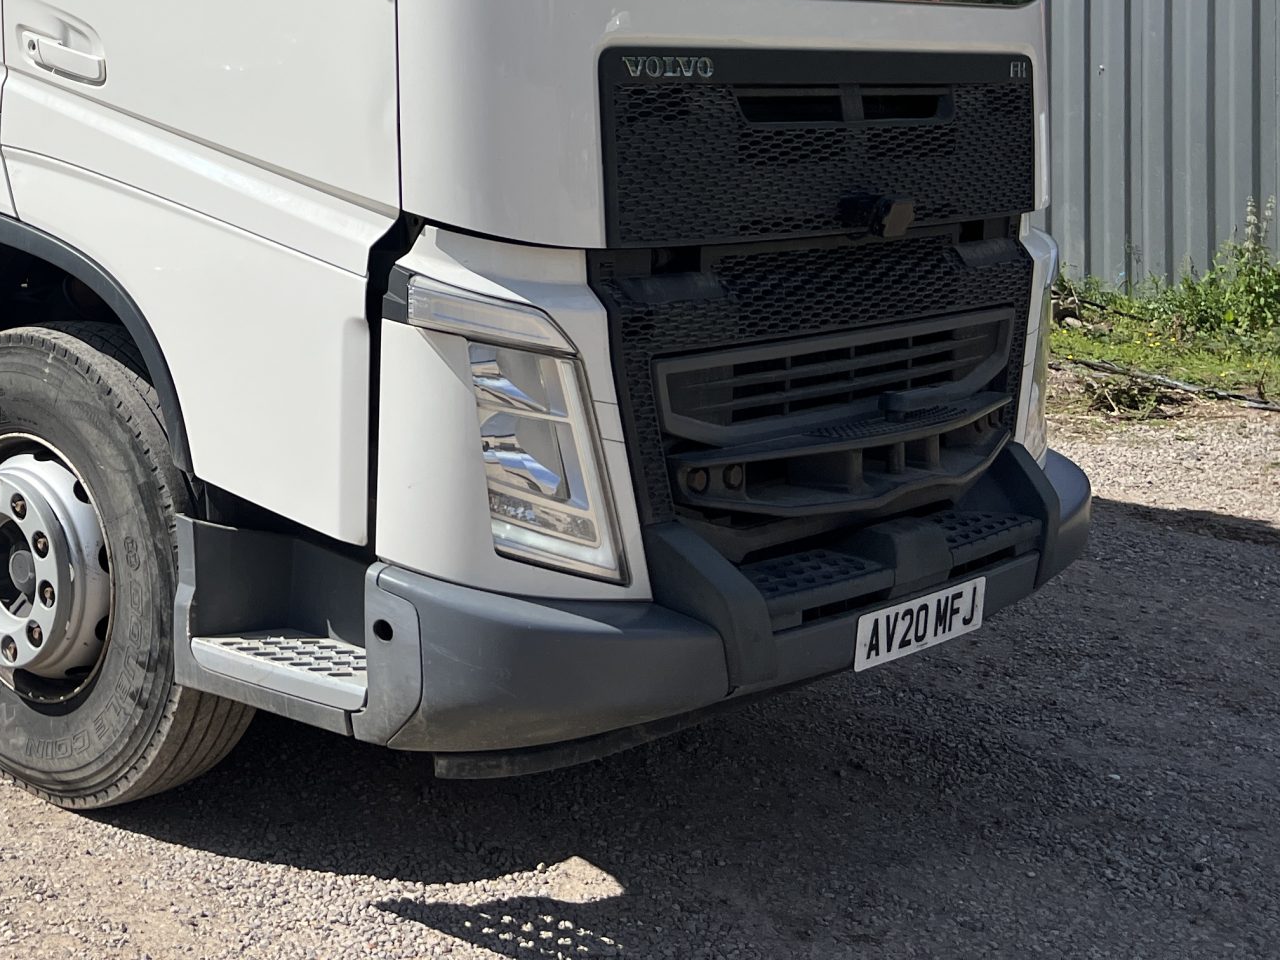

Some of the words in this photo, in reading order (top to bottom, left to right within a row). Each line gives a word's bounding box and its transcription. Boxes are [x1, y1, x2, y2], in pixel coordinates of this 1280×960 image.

[622, 55, 715, 78] VOLVO
[865, 602, 930, 660] AV20
[933, 586, 977, 638] MFJ
